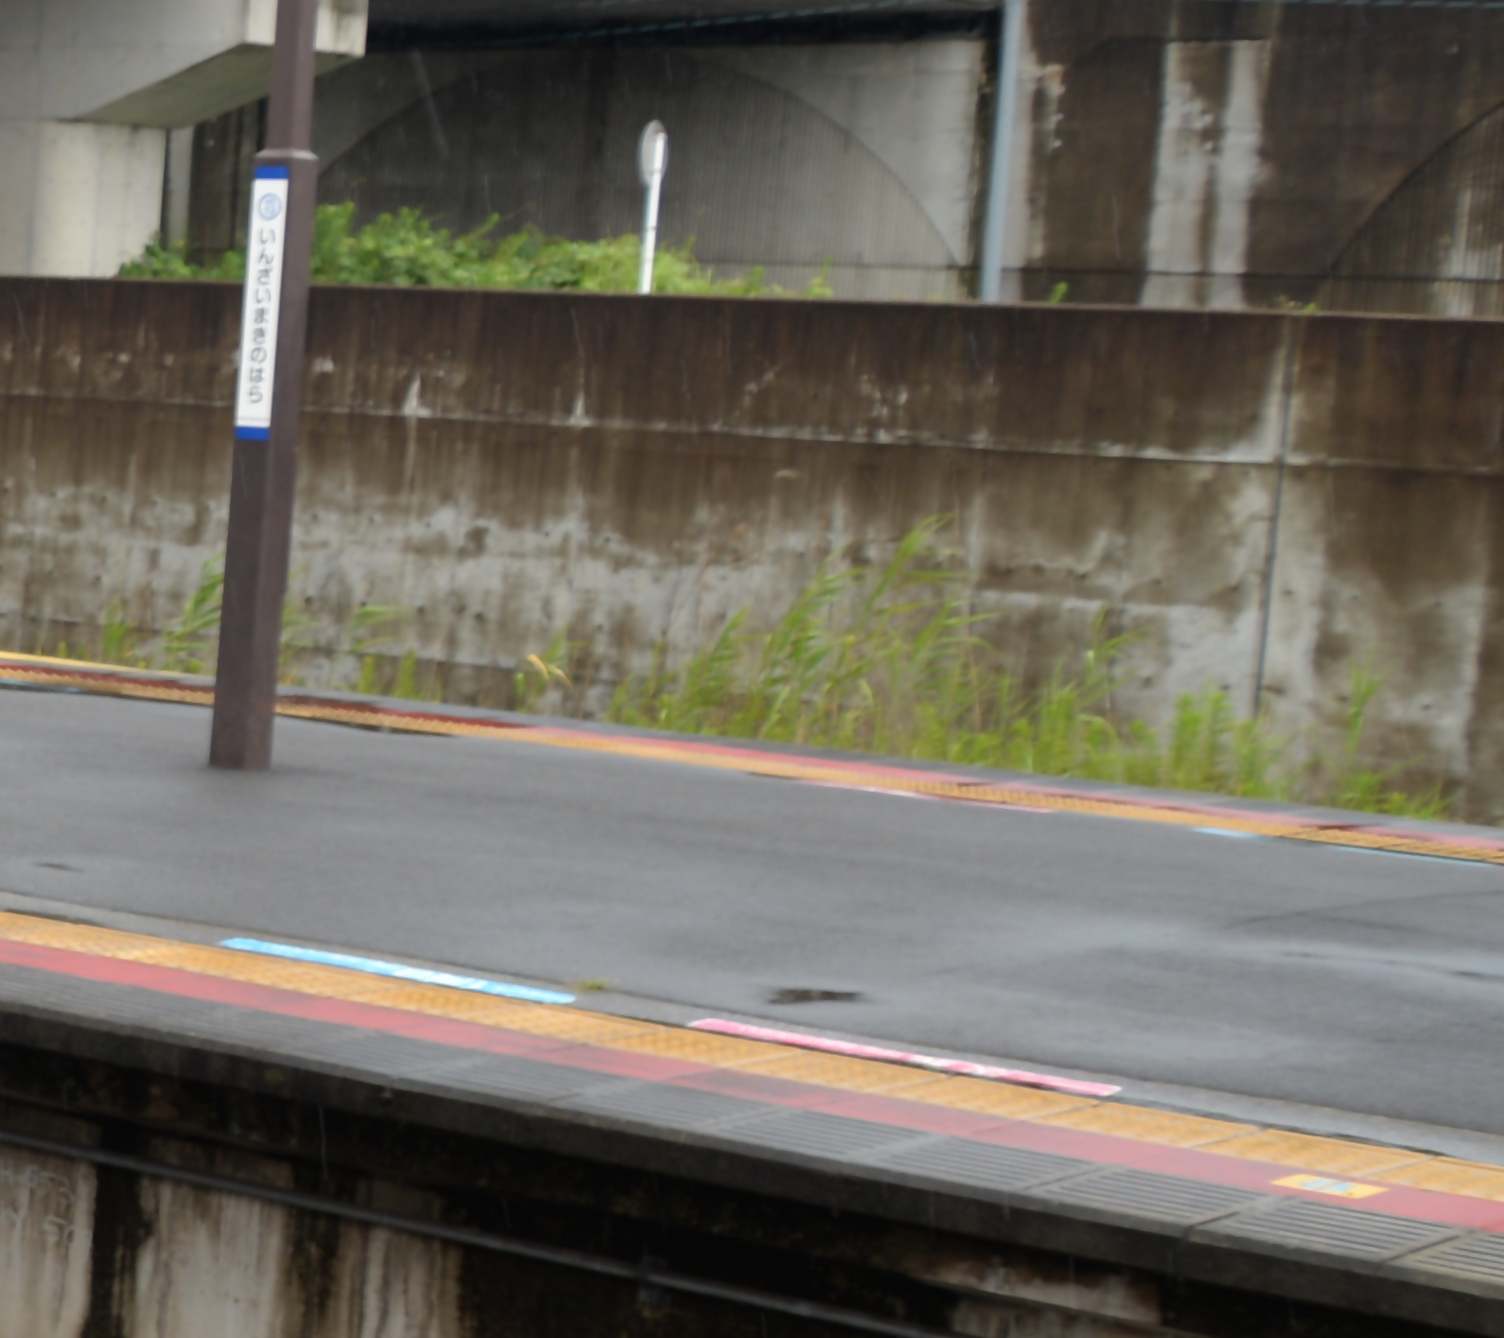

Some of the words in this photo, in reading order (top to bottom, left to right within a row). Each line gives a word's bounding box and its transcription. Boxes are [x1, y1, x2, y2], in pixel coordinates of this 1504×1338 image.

[248, 227, 277, 405] いんざいまきのはら
